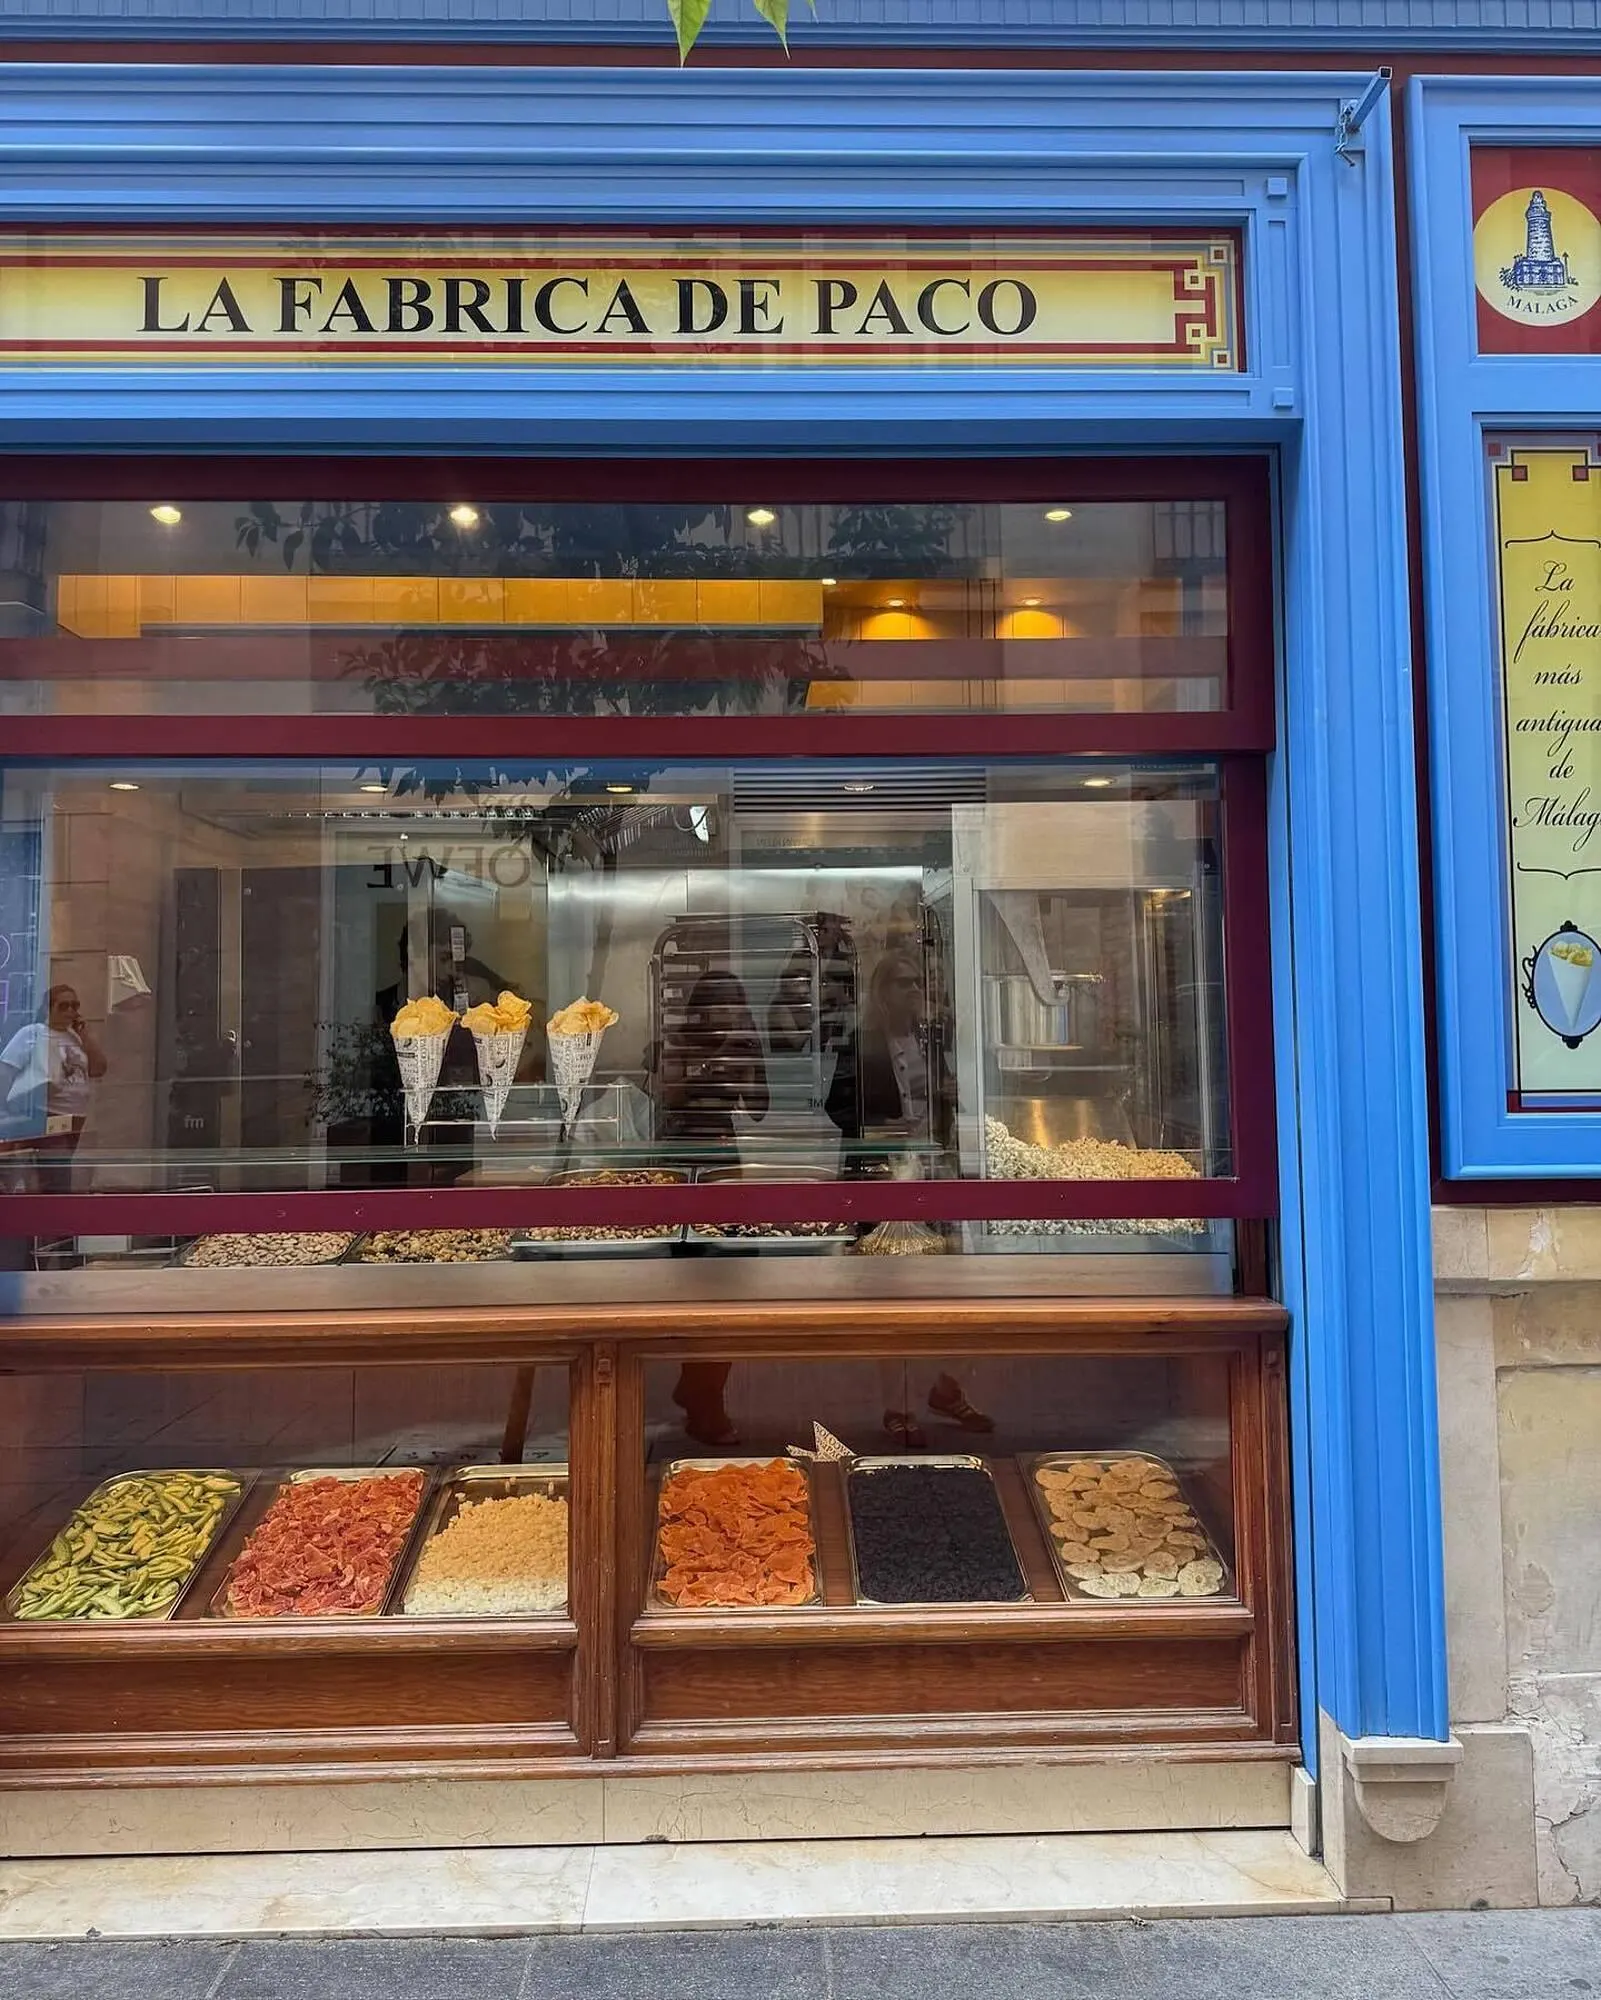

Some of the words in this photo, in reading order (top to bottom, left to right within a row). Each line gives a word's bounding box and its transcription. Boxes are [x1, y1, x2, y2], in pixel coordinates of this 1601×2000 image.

[137, 276, 252, 333] LA
[274, 277, 652, 335] FABRICA
[672, 277, 783, 334] DE
[811, 278, 1037, 336] PACO
[1506, 295, 1579, 315] MALAGA
[1535, 560, 1574, 592] La
[1513, 599, 1601, 664] fábrica
[1534, 663, 1582, 685] más
[1516, 710, 1601, 757] antigua
[1549, 748, 1574, 779] de
[1513, 787, 1601, 852] Málag
